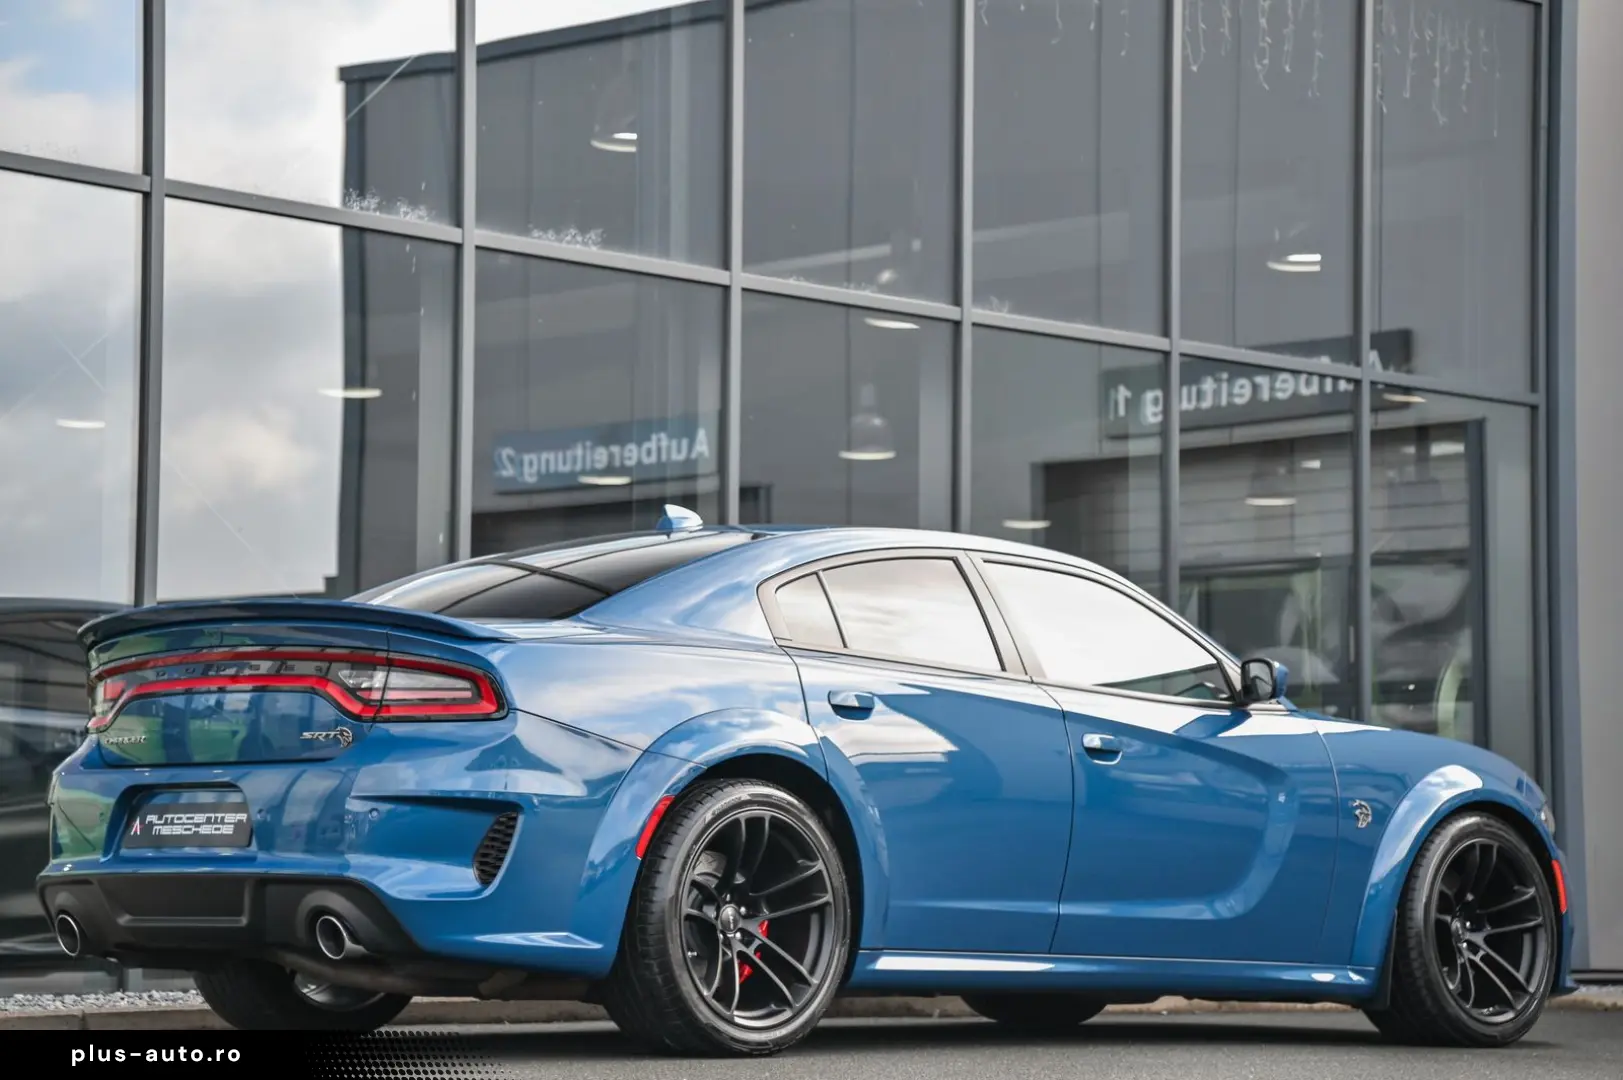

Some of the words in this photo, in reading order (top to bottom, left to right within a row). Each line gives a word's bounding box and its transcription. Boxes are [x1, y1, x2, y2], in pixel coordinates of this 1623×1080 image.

[300, 731, 340, 741] SRT
[145, 813, 248, 824] AUTOCENTER
[152, 824, 235, 835] MESCHEDE
